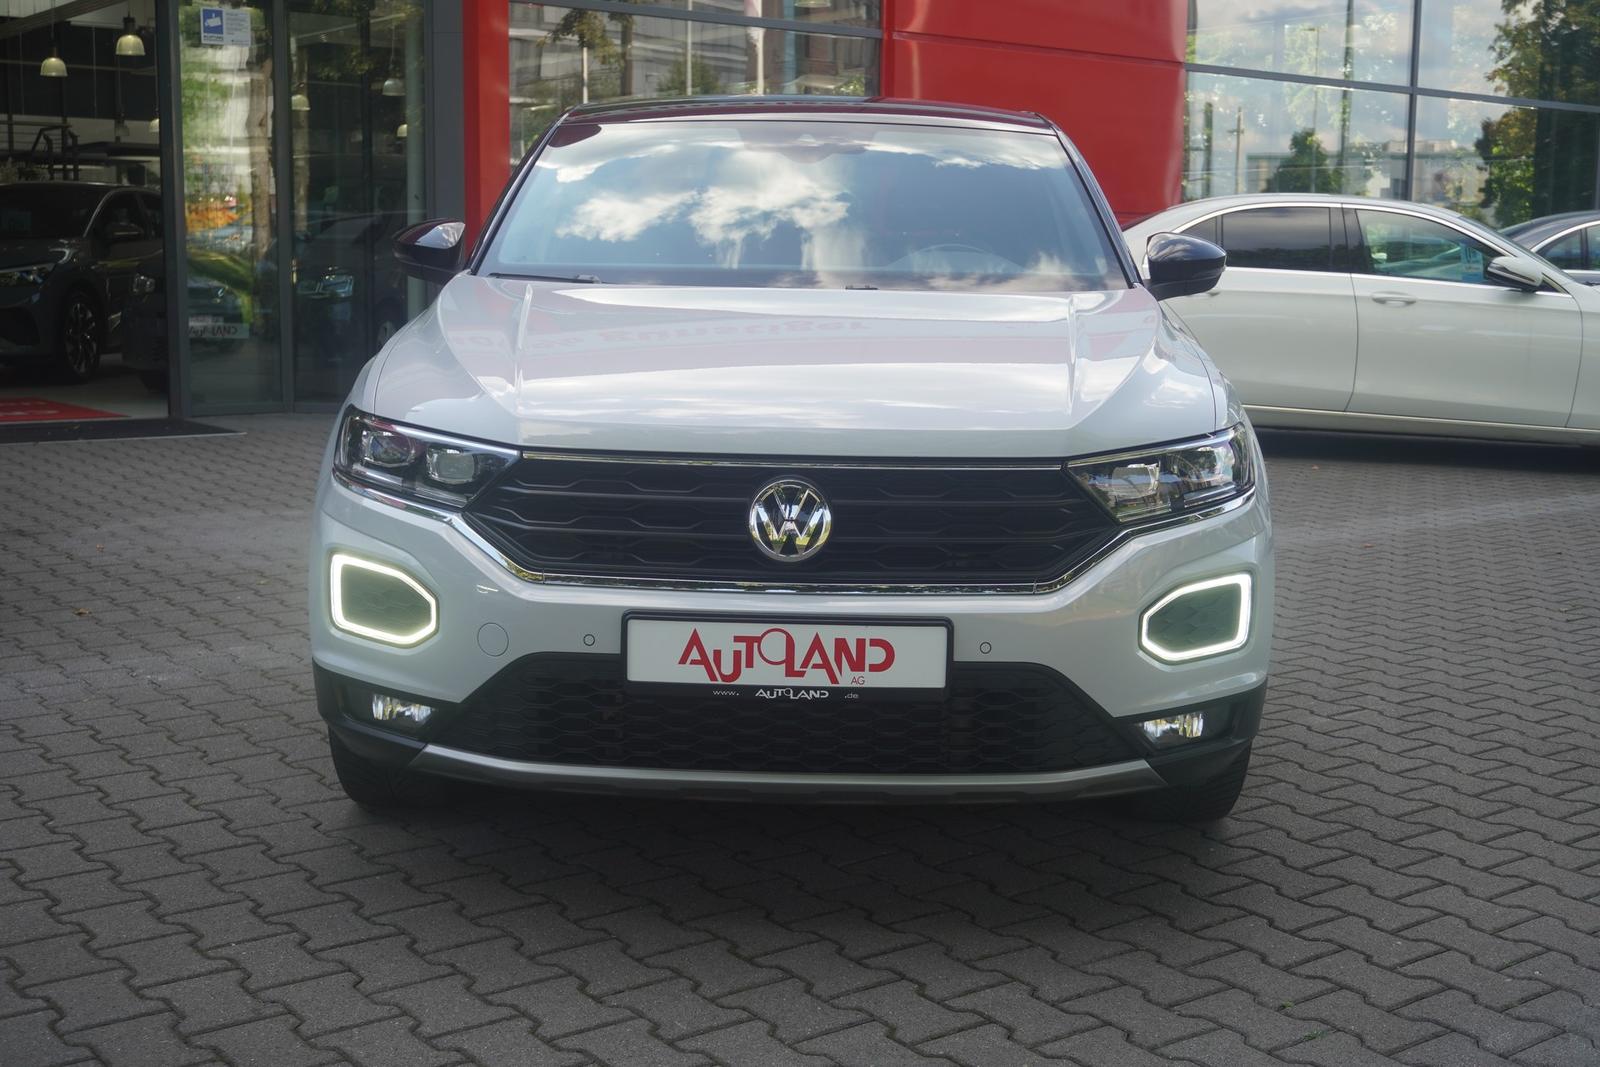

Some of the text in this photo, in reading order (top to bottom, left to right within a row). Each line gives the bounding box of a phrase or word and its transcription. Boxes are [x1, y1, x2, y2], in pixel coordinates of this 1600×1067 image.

[678, 628, 895, 684] AUTOLAND
[851, 676, 865, 685] AG
[755, 687, 829, 700] AUTOLAND
